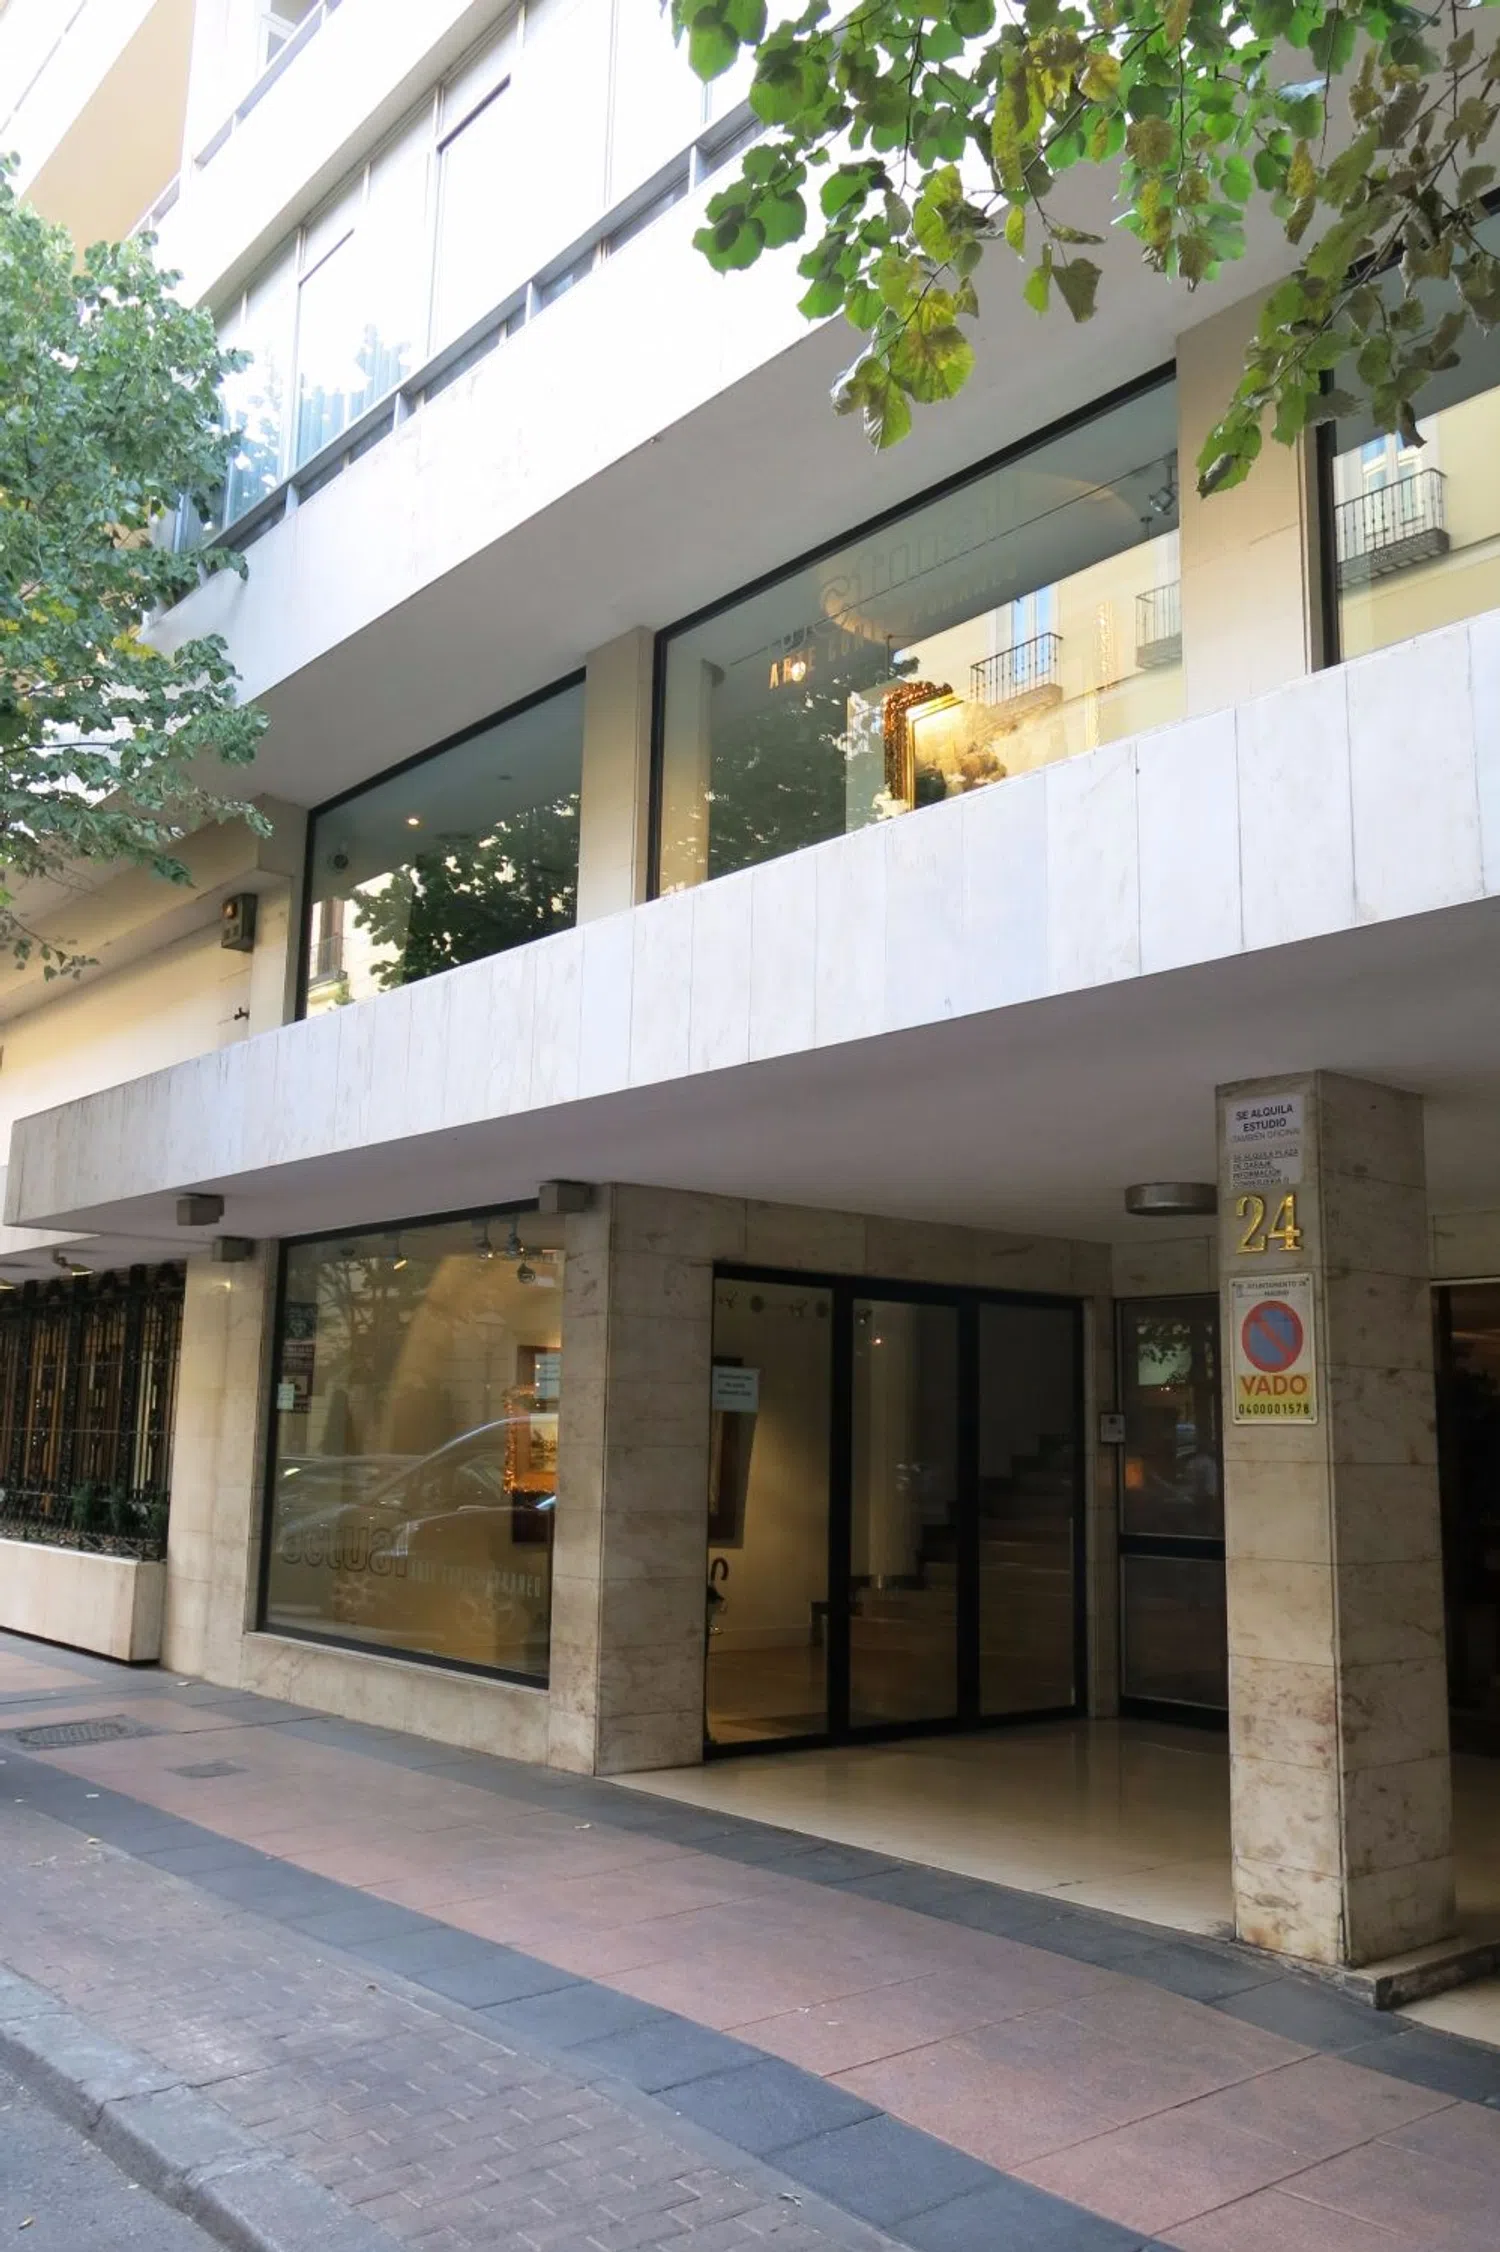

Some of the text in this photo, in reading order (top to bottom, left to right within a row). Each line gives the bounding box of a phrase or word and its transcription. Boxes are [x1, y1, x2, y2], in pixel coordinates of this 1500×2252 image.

[1236, 1104, 1293, 1121] SE ALQUILA
[1243, 1118, 1287, 1132] ESTUDIO
[1236, 1193, 1303, 1253] 24
[1241, 1375, 1308, 1396] VADO
